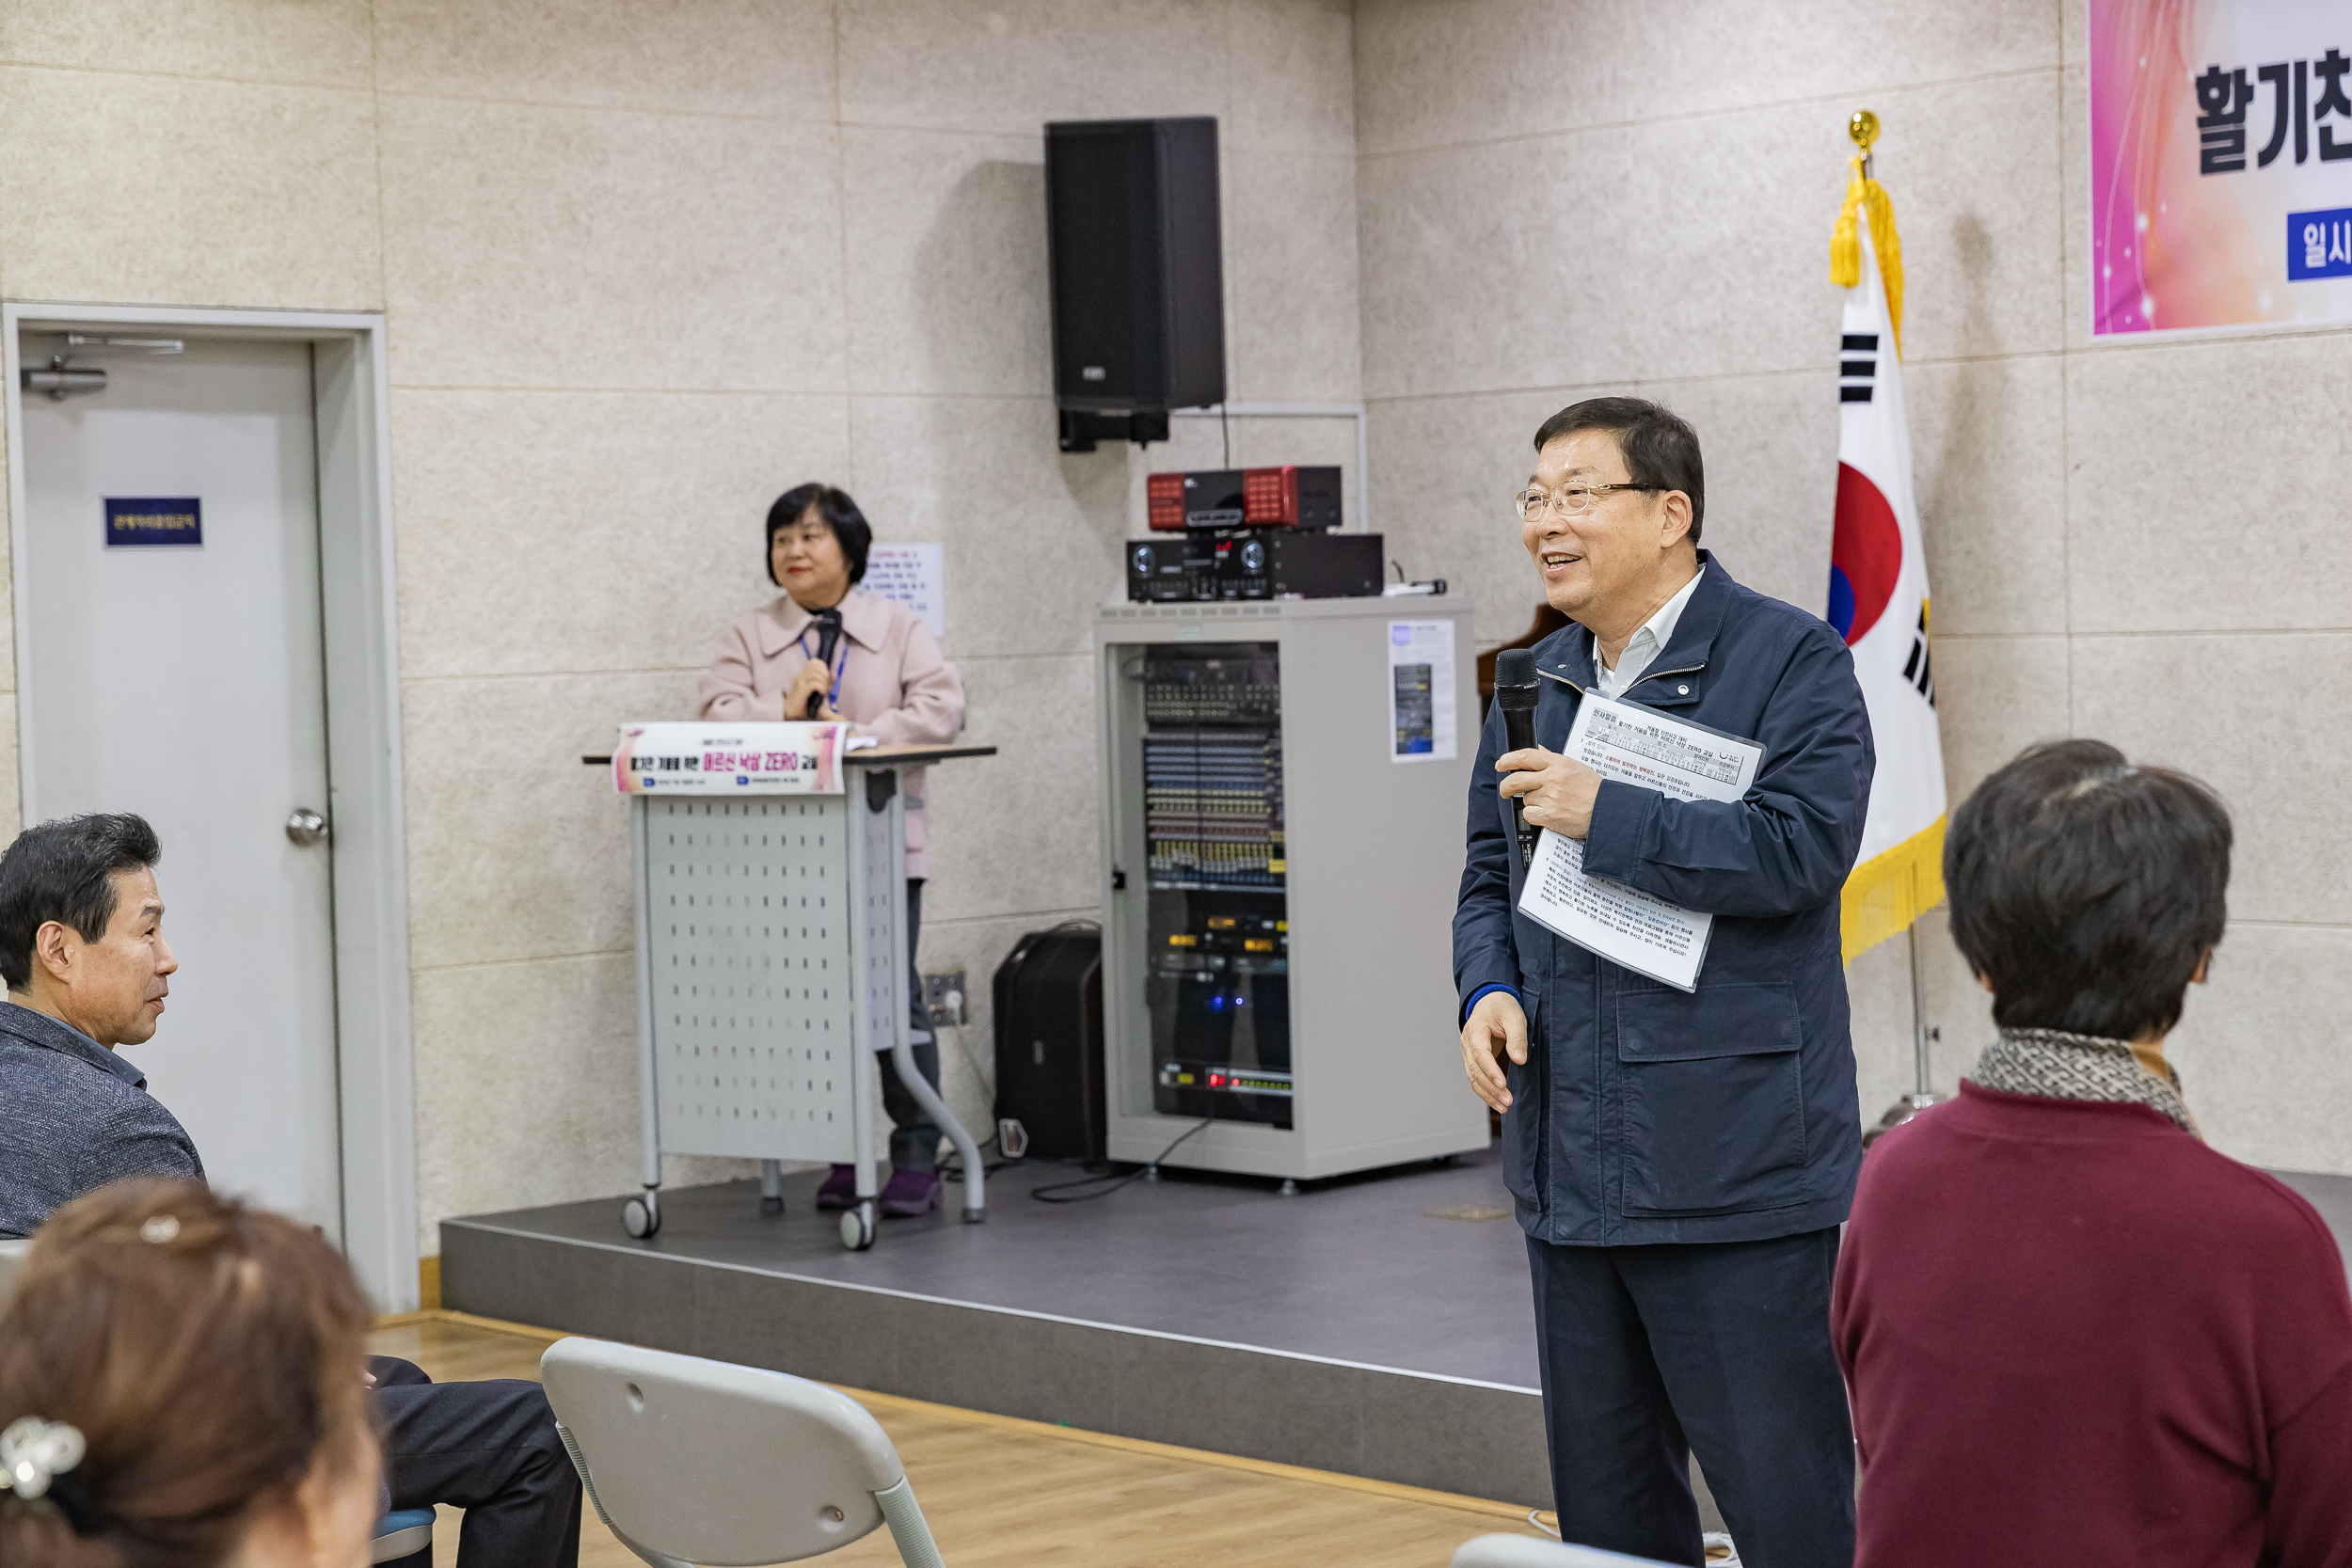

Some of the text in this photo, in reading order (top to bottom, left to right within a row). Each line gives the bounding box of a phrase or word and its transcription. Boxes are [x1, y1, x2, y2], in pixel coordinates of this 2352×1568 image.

[1649, 730, 1659, 739] 위한
[1661, 734, 1676, 745] 어르신
[1687, 744, 1702, 753] ZERO
[765, 752, 798, 771] ZERO
[1583, 748, 1603, 758] 반갑습니다.
[1605, 755, 1621, 764] 소통하며
[1622, 761, 1637, 770] 발전하는
[1603, 763, 1619, 772] 다가오는
[1621, 768, 1632, 777] 겨울을
[1647, 778, 1667, 788] 어르신들의
[1668, 784, 1680, 793] 안전과
